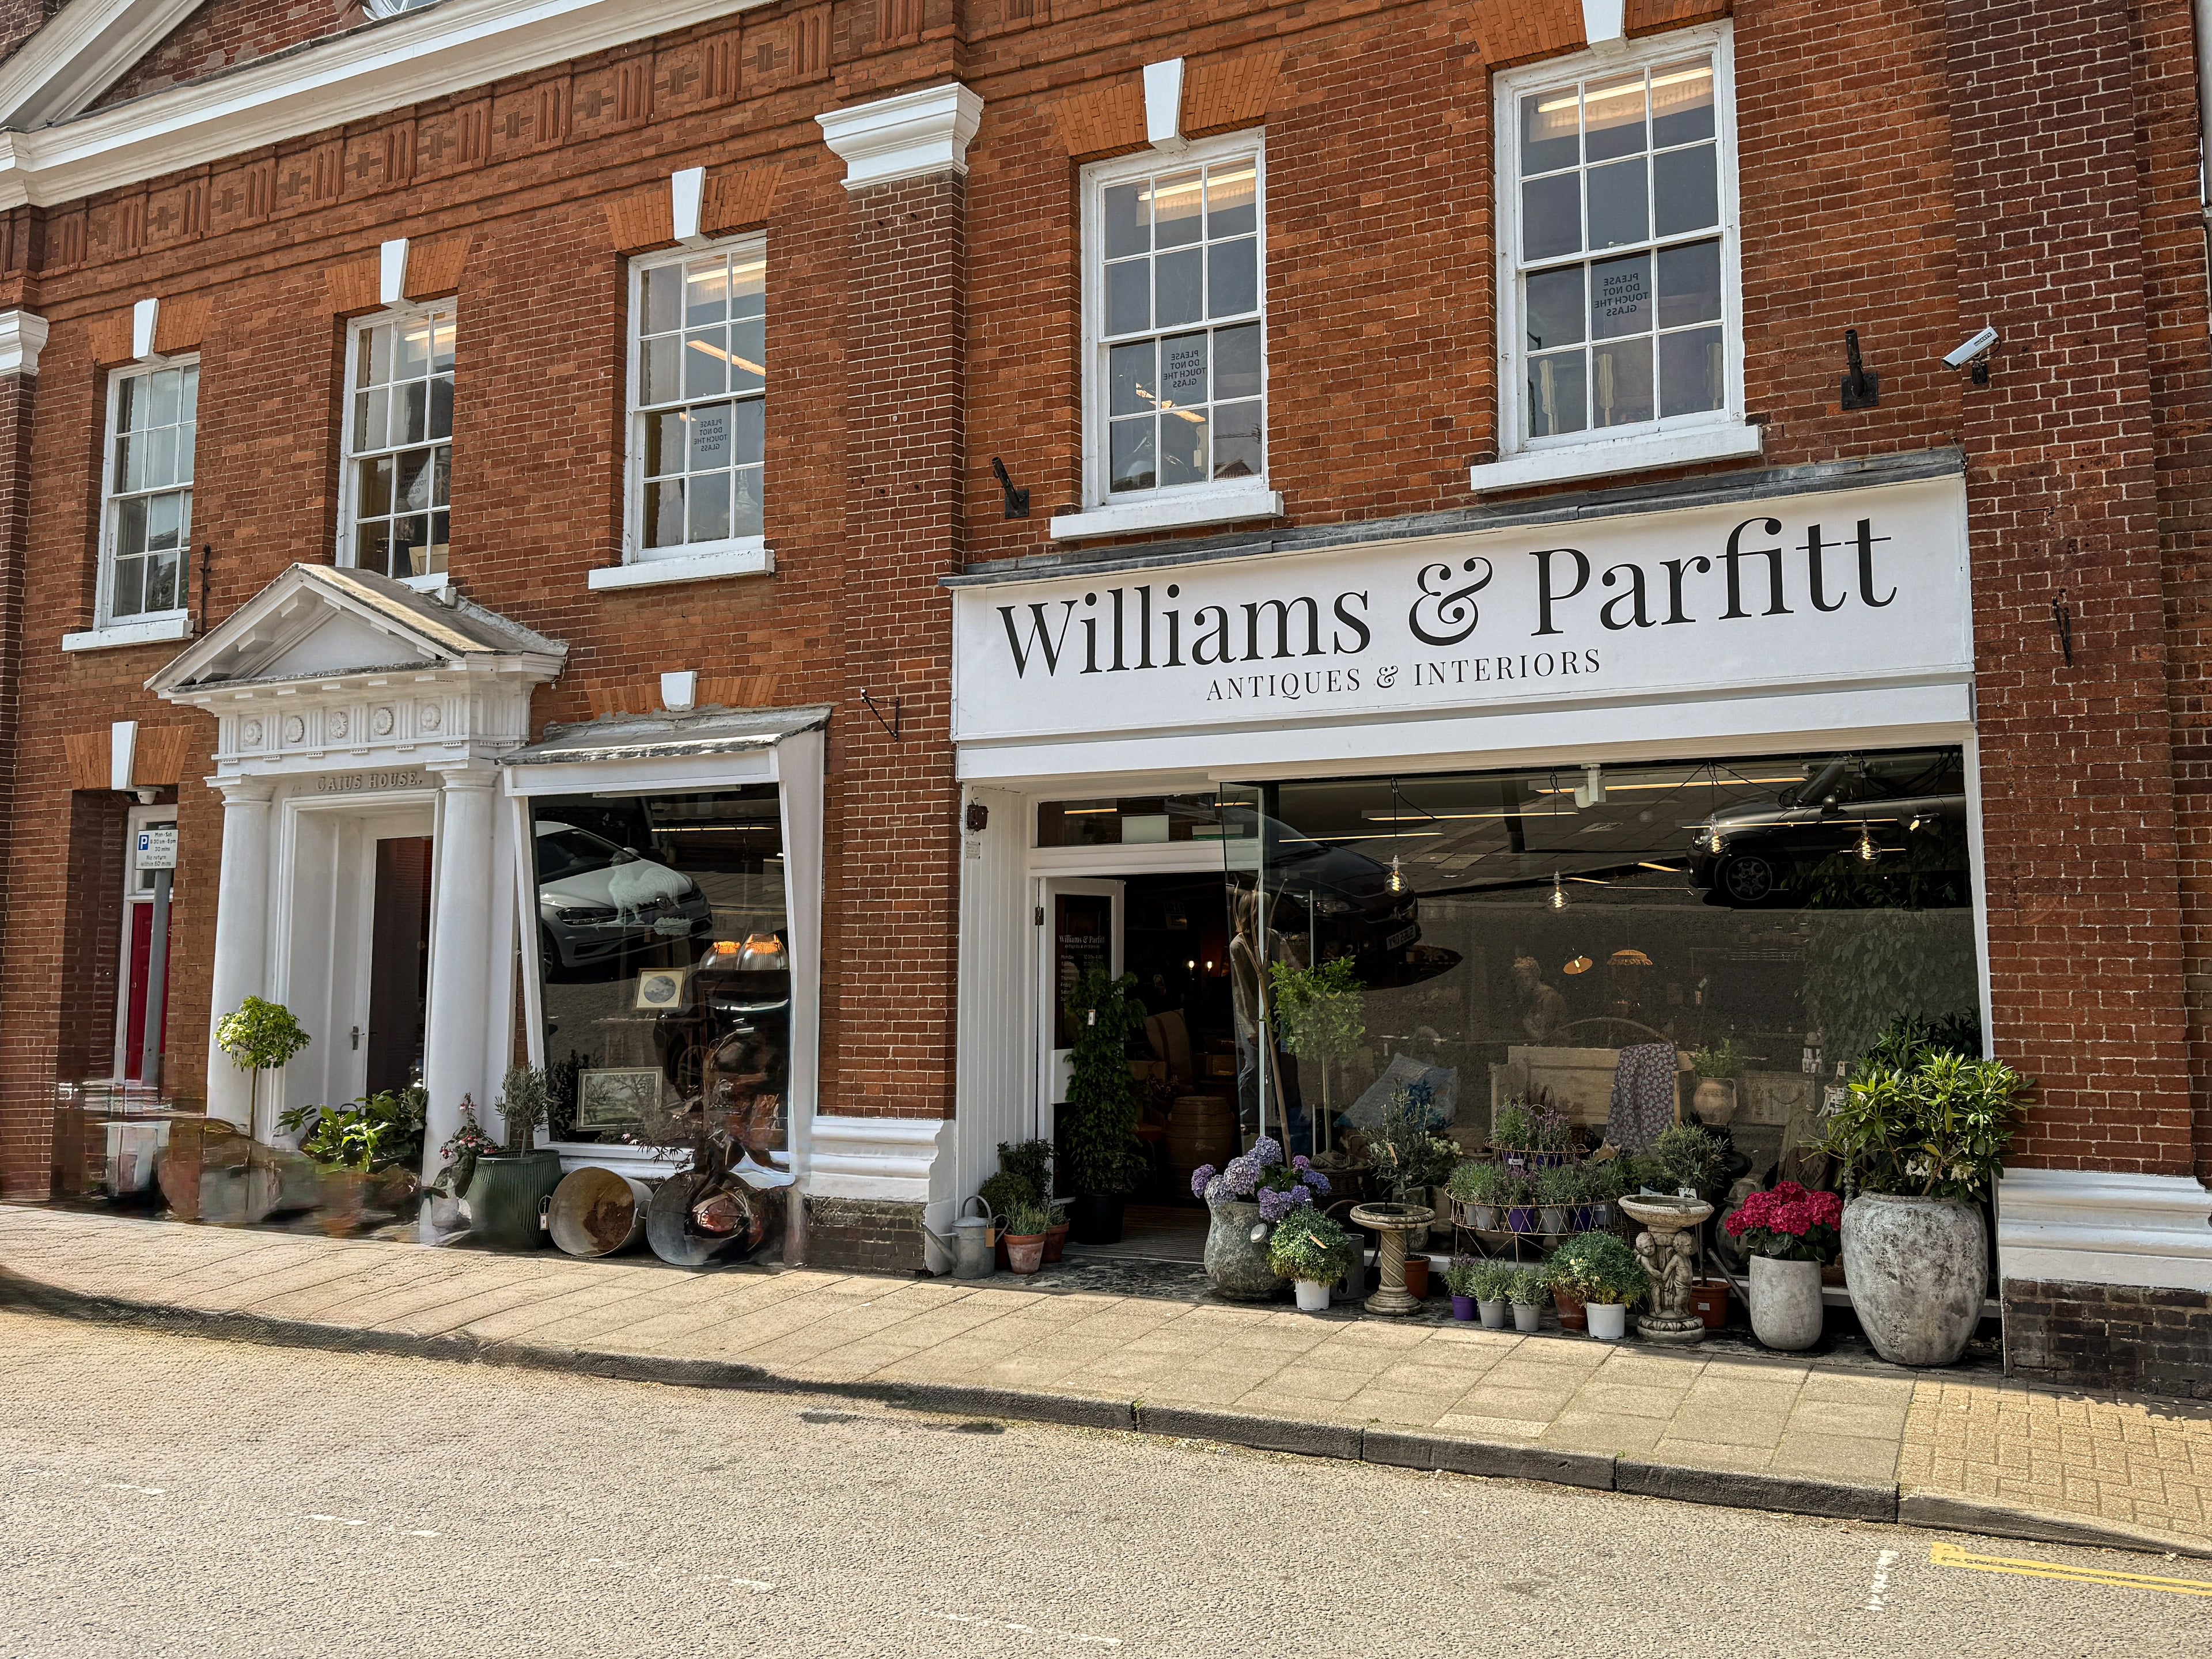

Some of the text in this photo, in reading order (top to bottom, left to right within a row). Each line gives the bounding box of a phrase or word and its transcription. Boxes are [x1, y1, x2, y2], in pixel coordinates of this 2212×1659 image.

[997, 517, 1897, 679] Williams & Parfitt
[1206, 649, 1600, 700] ANTIQUES & INTERIORS
[1059, 935, 1105, 944] Williams & Parfitt
